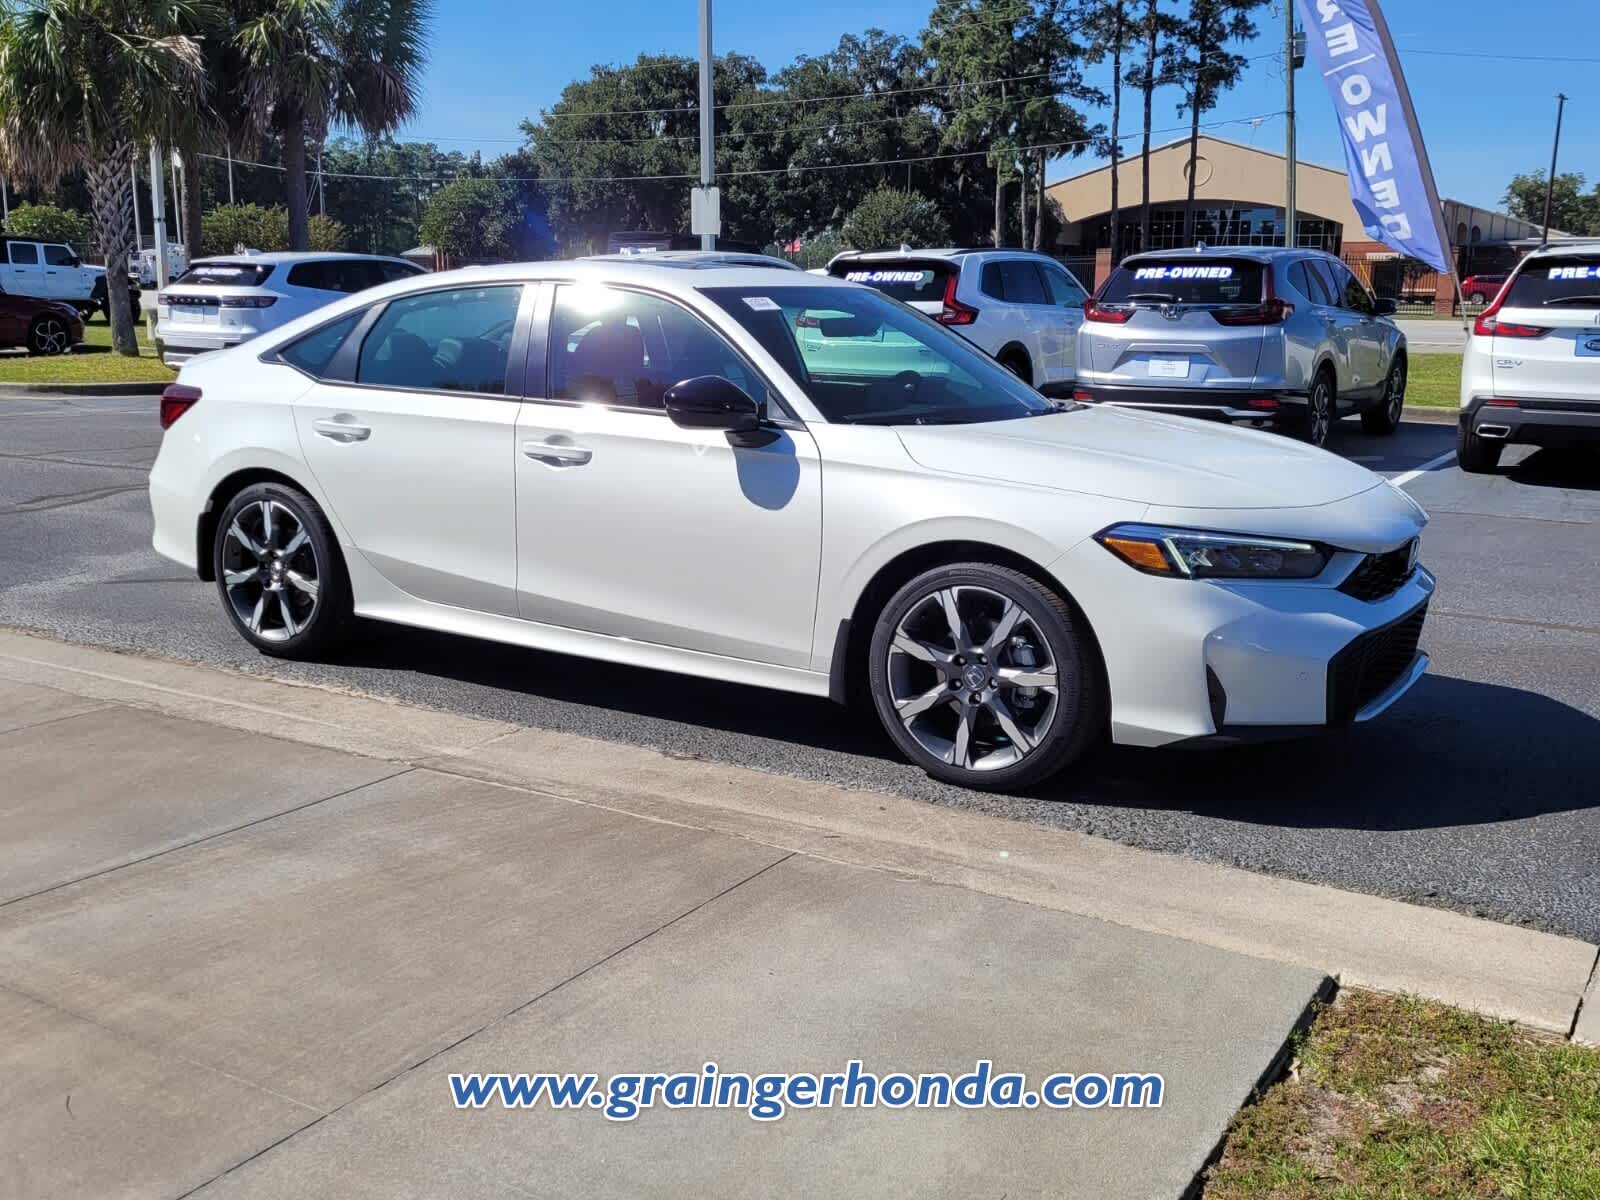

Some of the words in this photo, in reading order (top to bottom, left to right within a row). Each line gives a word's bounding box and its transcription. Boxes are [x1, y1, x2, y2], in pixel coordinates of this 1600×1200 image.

[845, 271, 924, 282] PRE-OWNED
[1134, 266, 1233, 280] PRE-OWNED
[1547, 266, 1600, 280] PRE-
